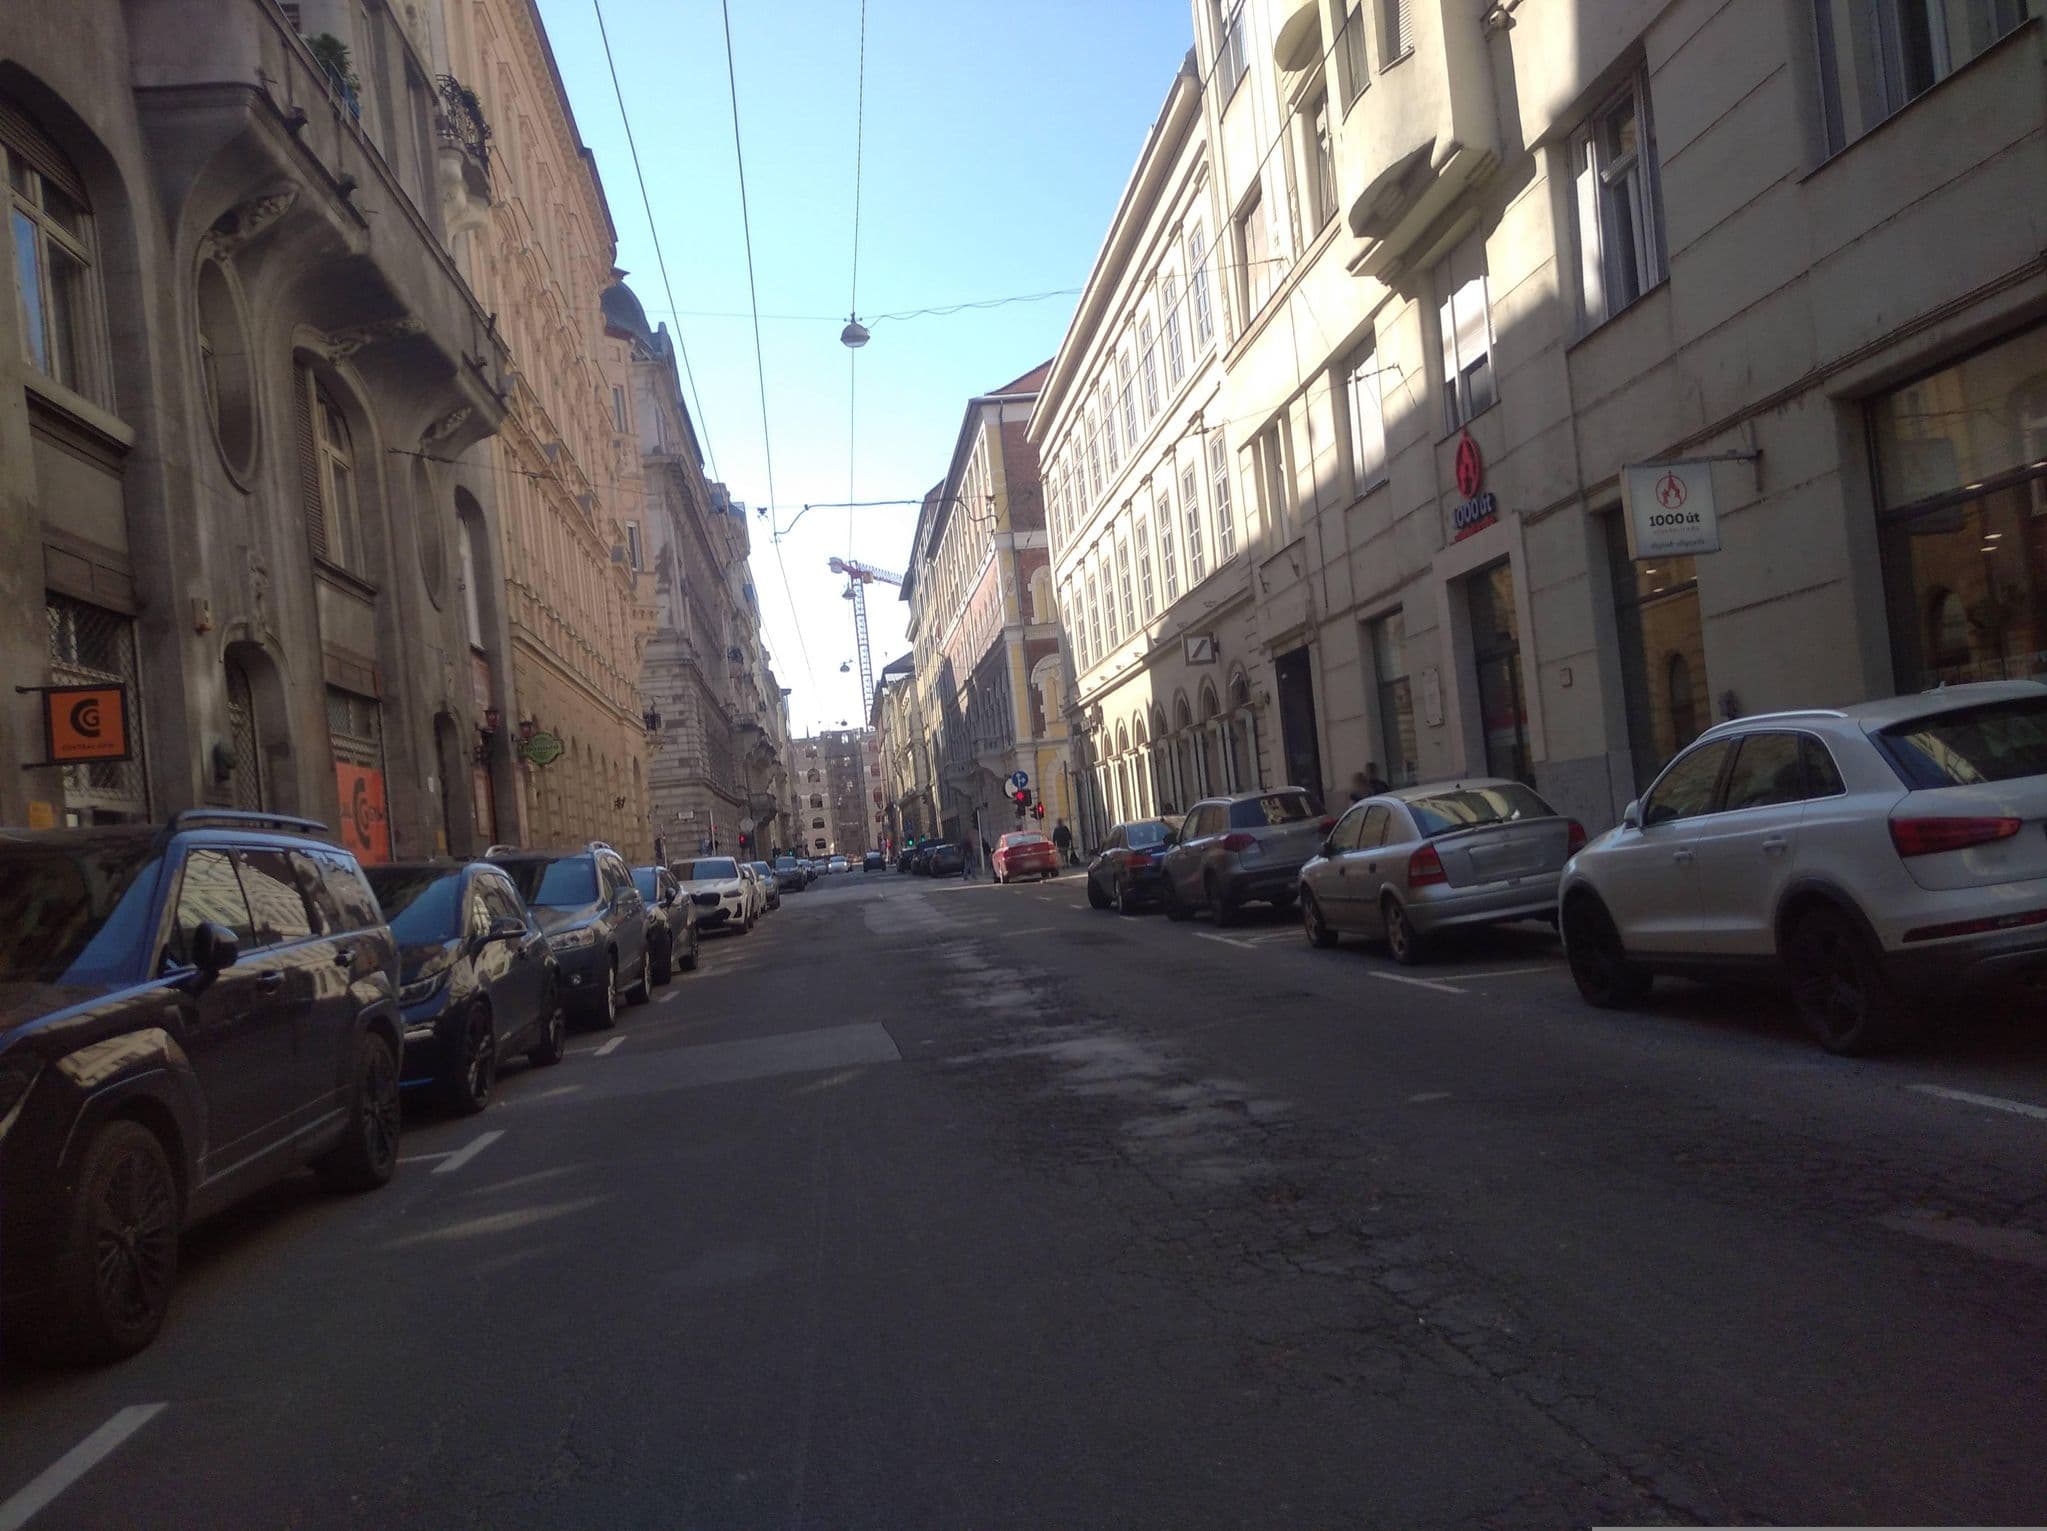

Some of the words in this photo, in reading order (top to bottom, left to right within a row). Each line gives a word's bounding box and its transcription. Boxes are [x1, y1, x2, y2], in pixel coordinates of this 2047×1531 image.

[1451, 498, 1479, 529] 1000
[1649, 513, 1684, 527] 1000
[1686, 512, 1700, 523] út
